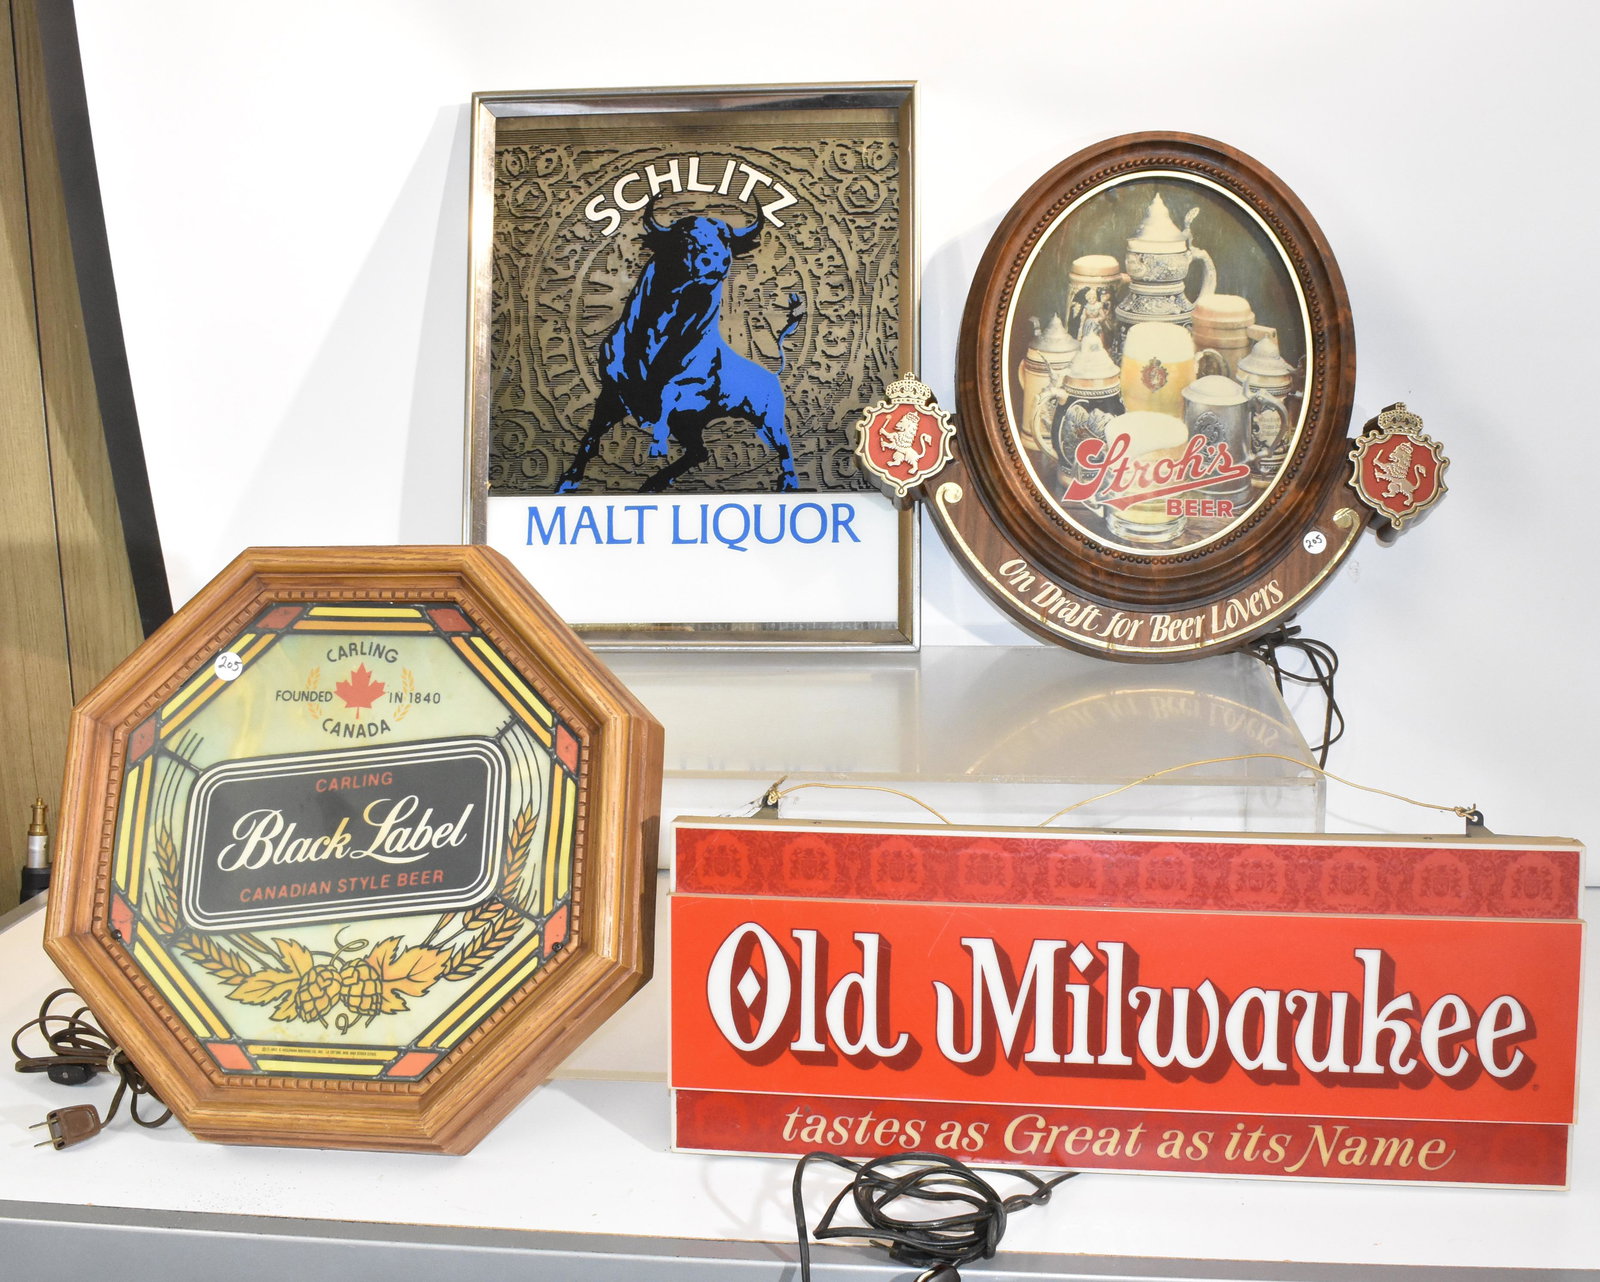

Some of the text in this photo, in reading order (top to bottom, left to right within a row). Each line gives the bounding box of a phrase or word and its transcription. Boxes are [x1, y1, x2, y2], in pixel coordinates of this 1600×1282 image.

[584, 156, 799, 237] SCHLITZ
[1061, 432, 1251, 512] Stroh's
[1165, 498, 1235, 519] BEER
[525, 502, 862, 553] MALT LIQUOR
[1305, 533, 1324, 549] 205
[998, 558, 1036, 593] On
[1031, 580, 1104, 632] Draft
[1097, 611, 1144, 642] for
[1149, 614, 1206, 643] Beer
[217, 655, 243, 672] 205
[326, 640, 399, 664] CARLING
[275, 689, 442, 705] FOUNDED IN 1840
[321, 717, 391, 739] CANADA
[315, 771, 394, 793] CARLING
[216, 794, 475, 872] Black Label
[239, 869, 445, 903] CANADIAN STYLE BEER
[706, 921, 1532, 1083] Old Milwaukee
[781, 1104, 1457, 1173] tastes as Great as its Name
